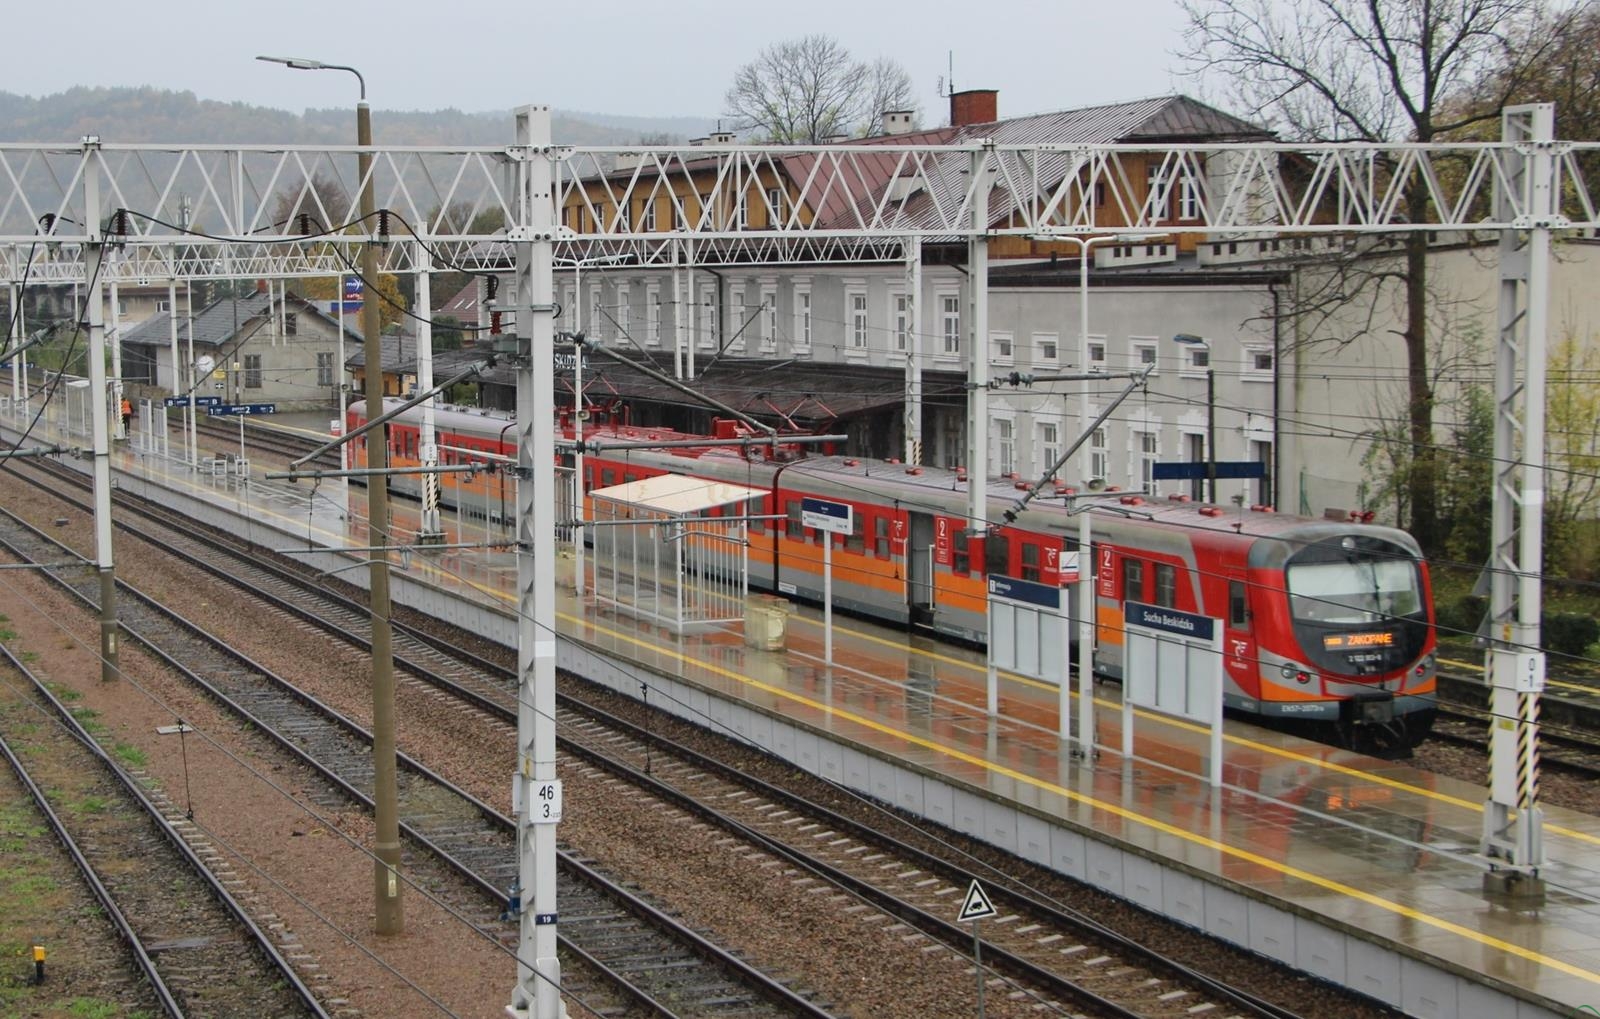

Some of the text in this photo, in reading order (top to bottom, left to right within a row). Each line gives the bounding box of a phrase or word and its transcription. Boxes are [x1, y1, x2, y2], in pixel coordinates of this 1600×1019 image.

[939, 520, 946, 537] 2
[1103, 550, 1111, 567] 2
[1143, 611, 1162, 624] Sucha
[1347, 633, 1393, 646] ZAKOPANE
[538, 784, 554, 800] 46
[543, 803, 550, 818] 3
[542, 915, 552, 923] 19
